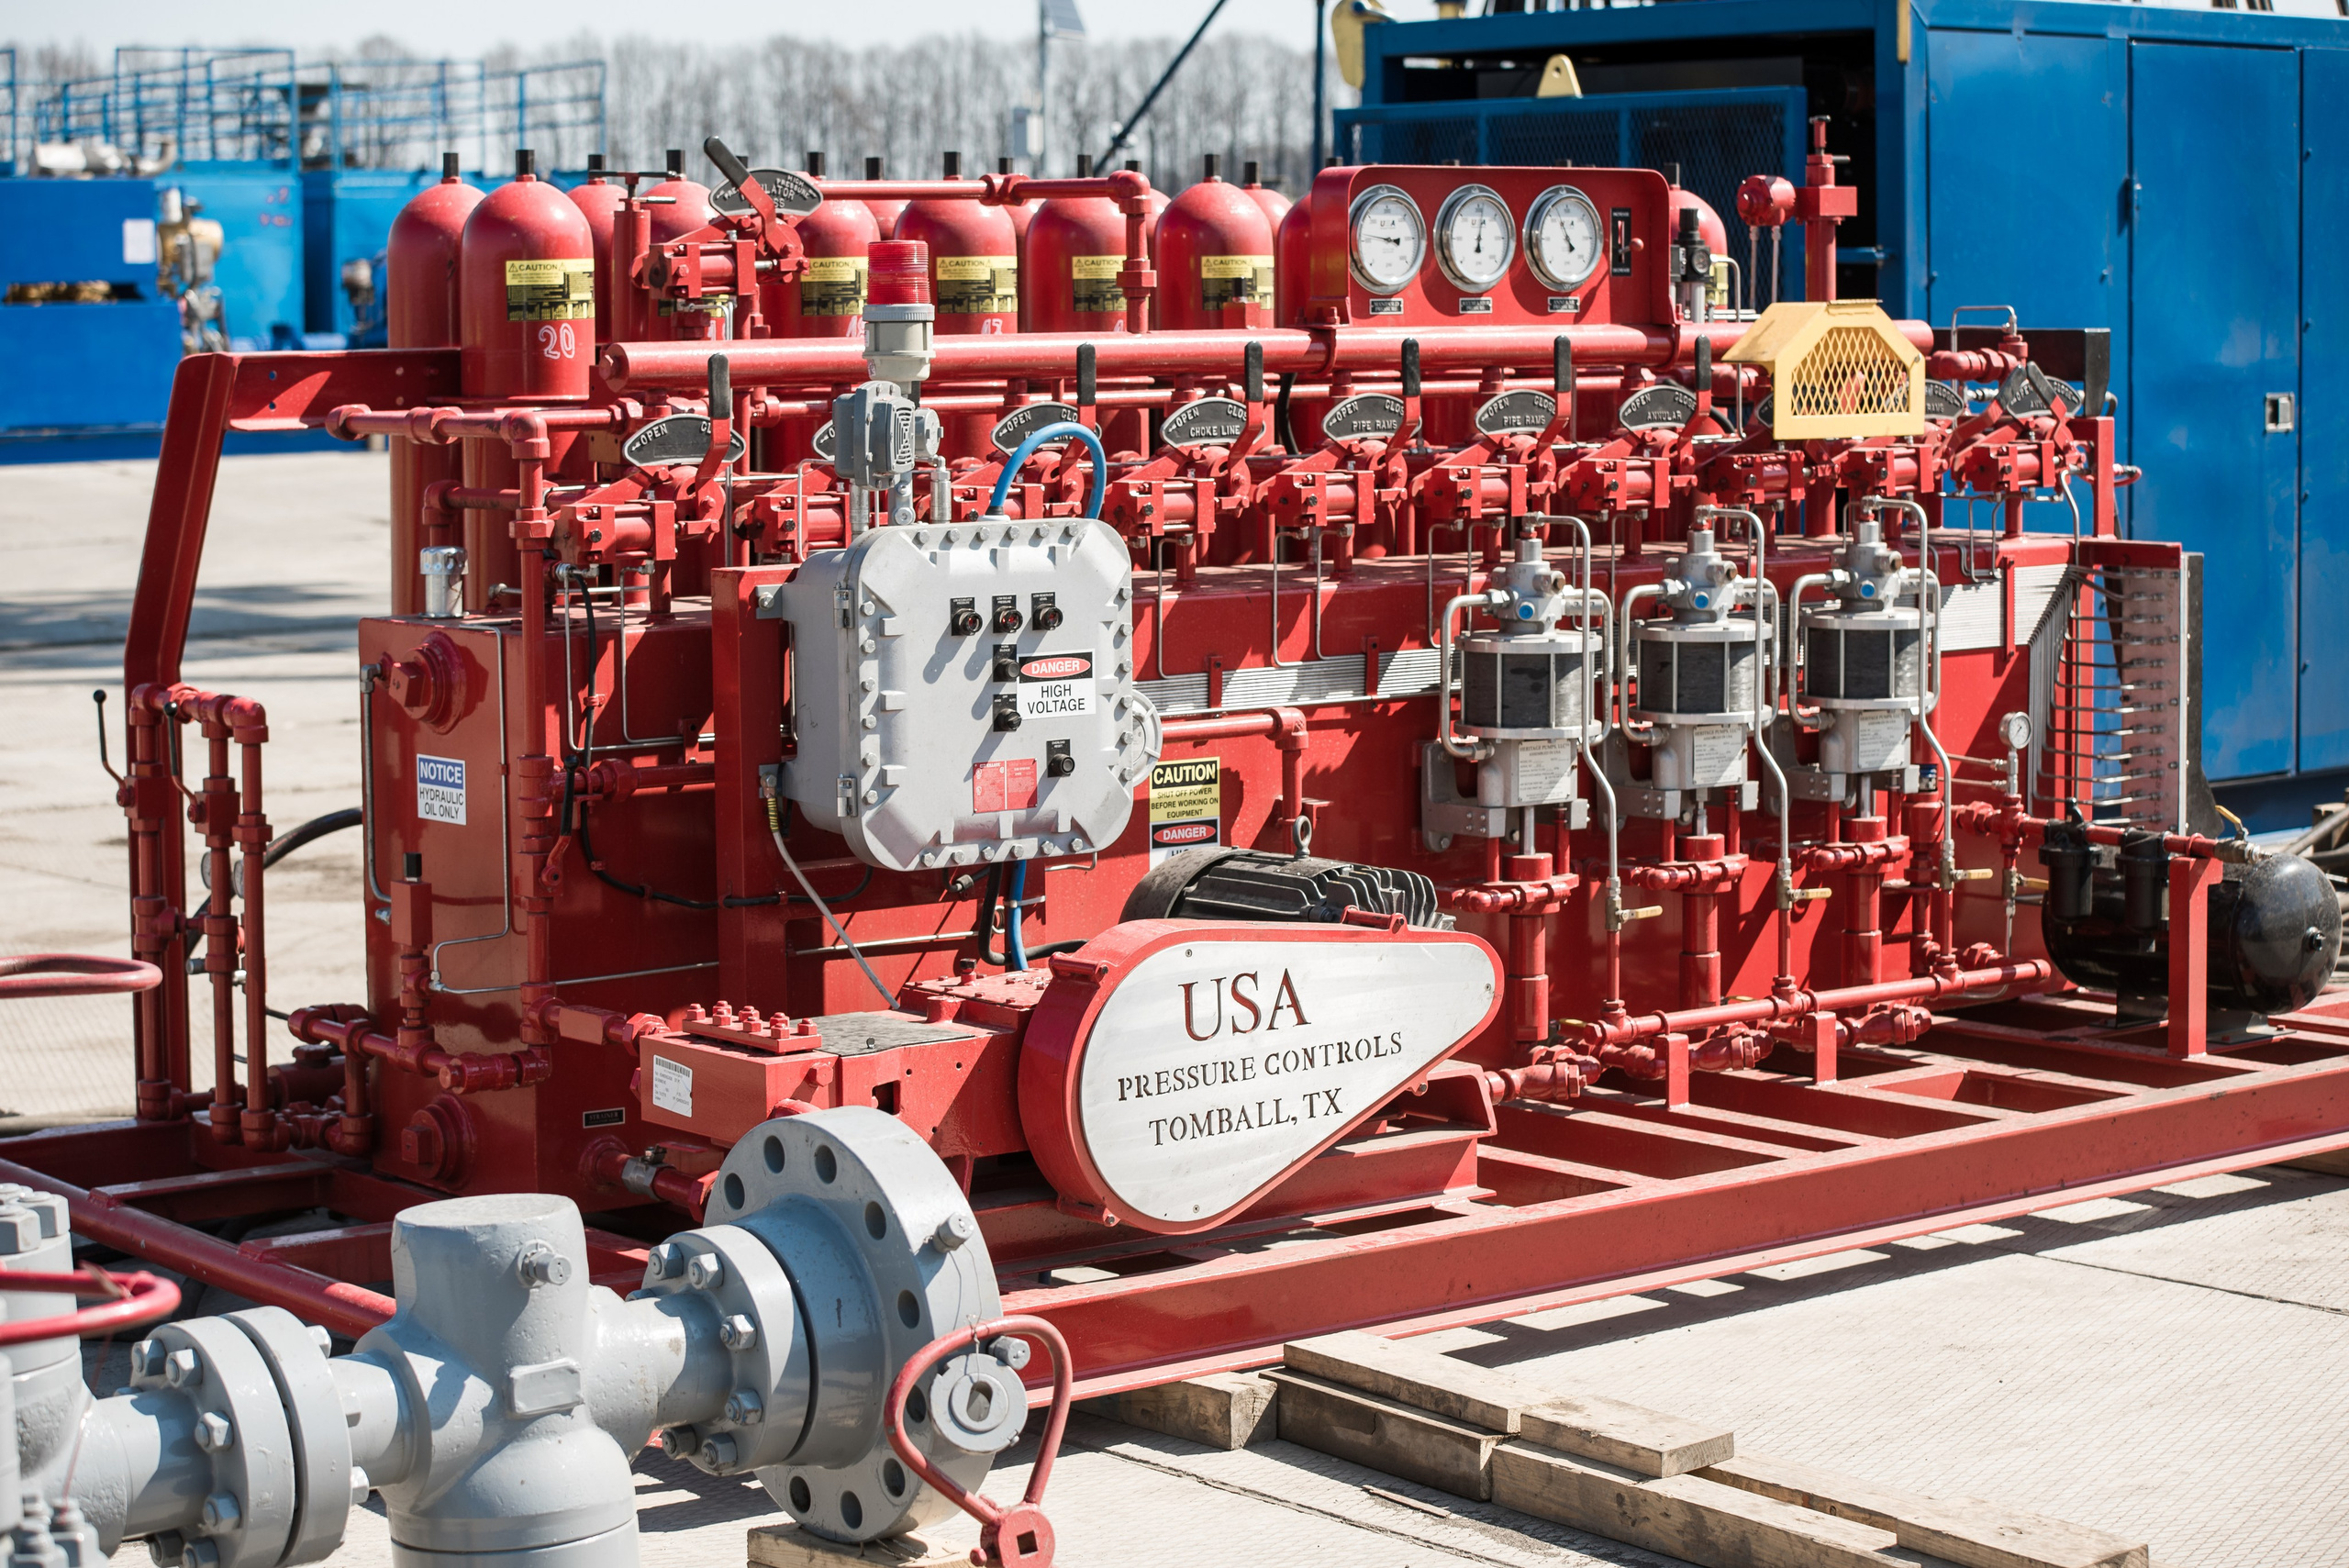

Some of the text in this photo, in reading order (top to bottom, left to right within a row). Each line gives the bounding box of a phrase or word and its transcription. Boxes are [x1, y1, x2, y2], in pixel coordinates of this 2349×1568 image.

[787, 175, 805, 186] HIGH
[518, 263, 558, 272] CAUTION
[813, 261, 850, 269] CAUTION
[539, 323, 575, 360] 20
[1386, 399, 1404, 416] CLOS
[1487, 396, 1509, 417] OPEN
[1631, 393, 1652, 412] OPEN
[1675, 392, 1697, 411] CLOSE
[1062, 408, 1078, 422] CLO
[1175, 406, 1199, 428] OPEN
[1228, 405, 1247, 421] CLOS
[1336, 401, 1358, 421] OPEN
[1647, 410, 1682, 421] ANNULAR
[1007, 410, 1032, 431] OPEN
[1353, 419, 1397, 431] PIPE RAMS
[1503, 415, 1546, 426] PIPE RAMS
[640, 423, 668, 445] OPEN
[1190, 425, 1241, 437] CHOKE LINE
[1031, 660, 1080, 674] DANGER
[1041, 684, 1072, 698] HIGH
[1028, 697, 1085, 715] VOLTAGE
[419, 761, 462, 784] NOTICE
[1152, 762, 1216, 785] CAUTION
[419, 786, 464, 806] HYDRAULIC
[1157, 787, 1212, 799] SHUT OFF POWER
[424, 802, 460, 819] OIL ONLY
[1151, 801, 1176, 810] BEFORE
[1177, 799, 1208, 807] WORKING
[1166, 808, 1204, 818] EQUIPMENT
[1163, 826, 1207, 841] DANGER
[1177, 967, 1312, 1042] USA
[1117, 1030, 1403, 1102] PRESSURE CONTROLS
[1301, 1086, 1343, 1119] TX
[589, 1111, 618, 1120] STRAINER
